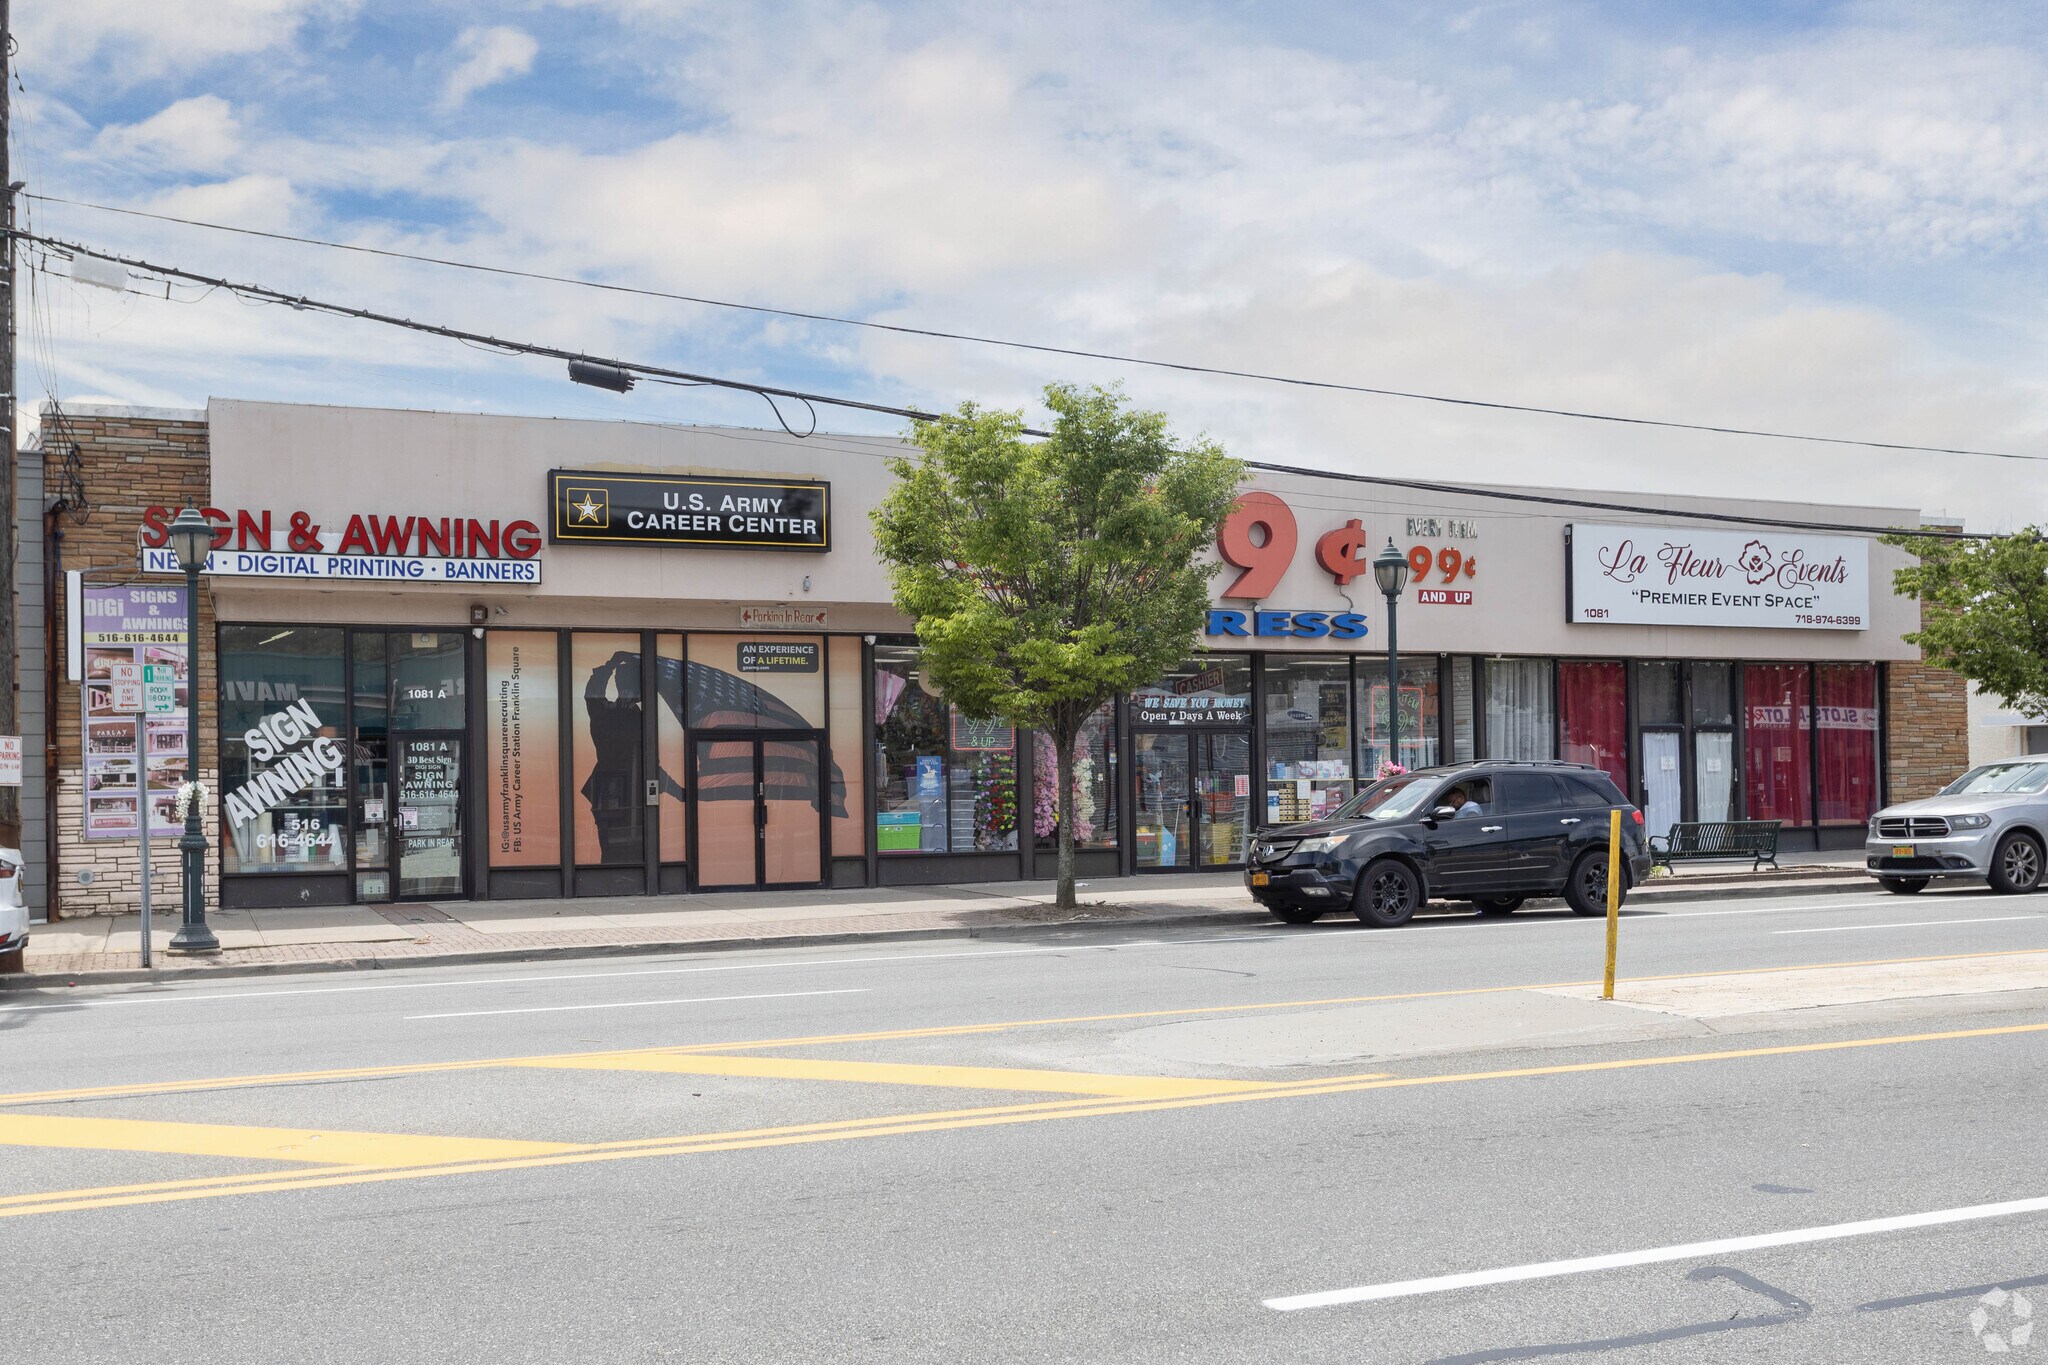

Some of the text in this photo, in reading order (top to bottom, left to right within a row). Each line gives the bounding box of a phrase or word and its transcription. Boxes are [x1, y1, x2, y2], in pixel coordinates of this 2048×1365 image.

[663, 492, 783, 514] U.S. ARMY
[627, 511, 817, 535] CAREER CENTER
[1406, 517, 1478, 539] EVERY ITEM
[287, 511, 324, 553] &
[338, 514, 542, 560] AWNING
[150, 551, 535, 581] NEN DIGITAL PRINTING BANNERS
[1598, 540, 1849, 591] La Fleur Events
[130, 590, 178, 604] SIGNS
[1420, 591, 1471, 603] AND UP
[1711, 592, 1761, 607] EVENT
[148, 604, 160, 616] &
[1584, 608, 1609, 618] 1081
[753, 608, 815, 625] Parking In Rear
[1795, 614, 1861, 625] 718-974-6399
[1205, 610, 1369, 640] RESS
[98, 633, 179, 643] 516-616-4644
[742, 645, 814, 654] AN EXPERIENCE
[742, 656, 809, 665] OF A LIFETIME.
[120, 667, 133, 677] NO
[146, 669, 151, 681] 1
[1180, 671, 1221, 695] CASHIER
[408, 689, 447, 699] 1081 A
[1144, 697, 1160, 709] WE
[1163, 697, 1187, 709] SAVE
[1190, 697, 1210, 709] YOU
[1212, 697, 1247, 709] MONEY
[1141, 710, 1242, 722] Open 7 Days A Week
[244, 697, 323, 762] SIGN
[4, 741, 15, 751] NO
[409, 742, 448, 752] 1081 A
[981, 737, 996, 747] UP
[511, 646, 524, 853] FB: US Army Career Station Franklin Square
[407, 755, 452, 765] 3D Best Sign
[414, 771, 444, 780] SIGN
[224, 736, 343, 829] AWNING
[405, 780, 454, 789] AWNING
[400, 790, 459, 799] 516-616-4644
[291, 819, 321, 831] 516
[256, 833, 338, 848] 616-4644
[408, 838, 455, 848] PARK IN REAR
